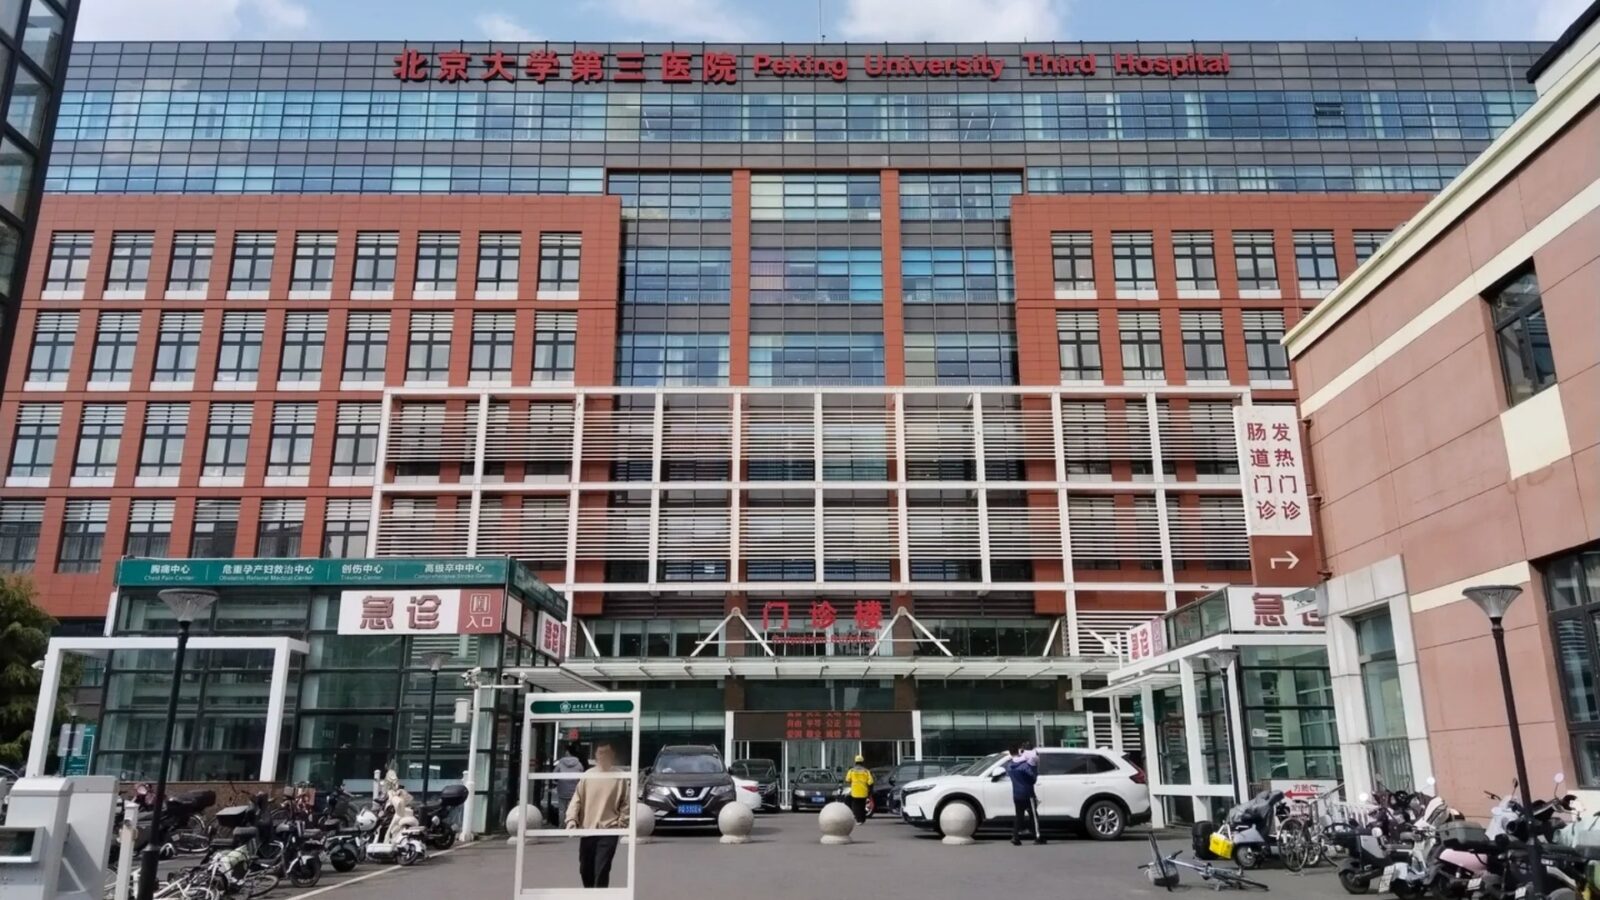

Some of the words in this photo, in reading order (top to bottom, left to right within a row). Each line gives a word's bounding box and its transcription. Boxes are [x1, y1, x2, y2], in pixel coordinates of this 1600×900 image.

[393, 49, 737, 84] 北京大学第三医院
[753, 54, 848, 81] Peking
[864, 53, 1005, 81] University
[1022, 53, 1096, 76] Third
[1114, 53, 1230, 79] Hospital
[1247, 422, 1277, 520] 肠道门诊
[1272, 422, 1301, 520] 发热门诊
[150, 564, 191, 574] 胸痛中心
[222, 564, 315, 575] 危重孕产妇救治中心
[341, 564, 384, 574] 创伤中心
[424, 563, 485, 573] 高级卒中中心
[360, 595, 441, 630] 急诊
[466, 616, 493, 628] 入口
[763, 600, 882, 630] 门诊楼
